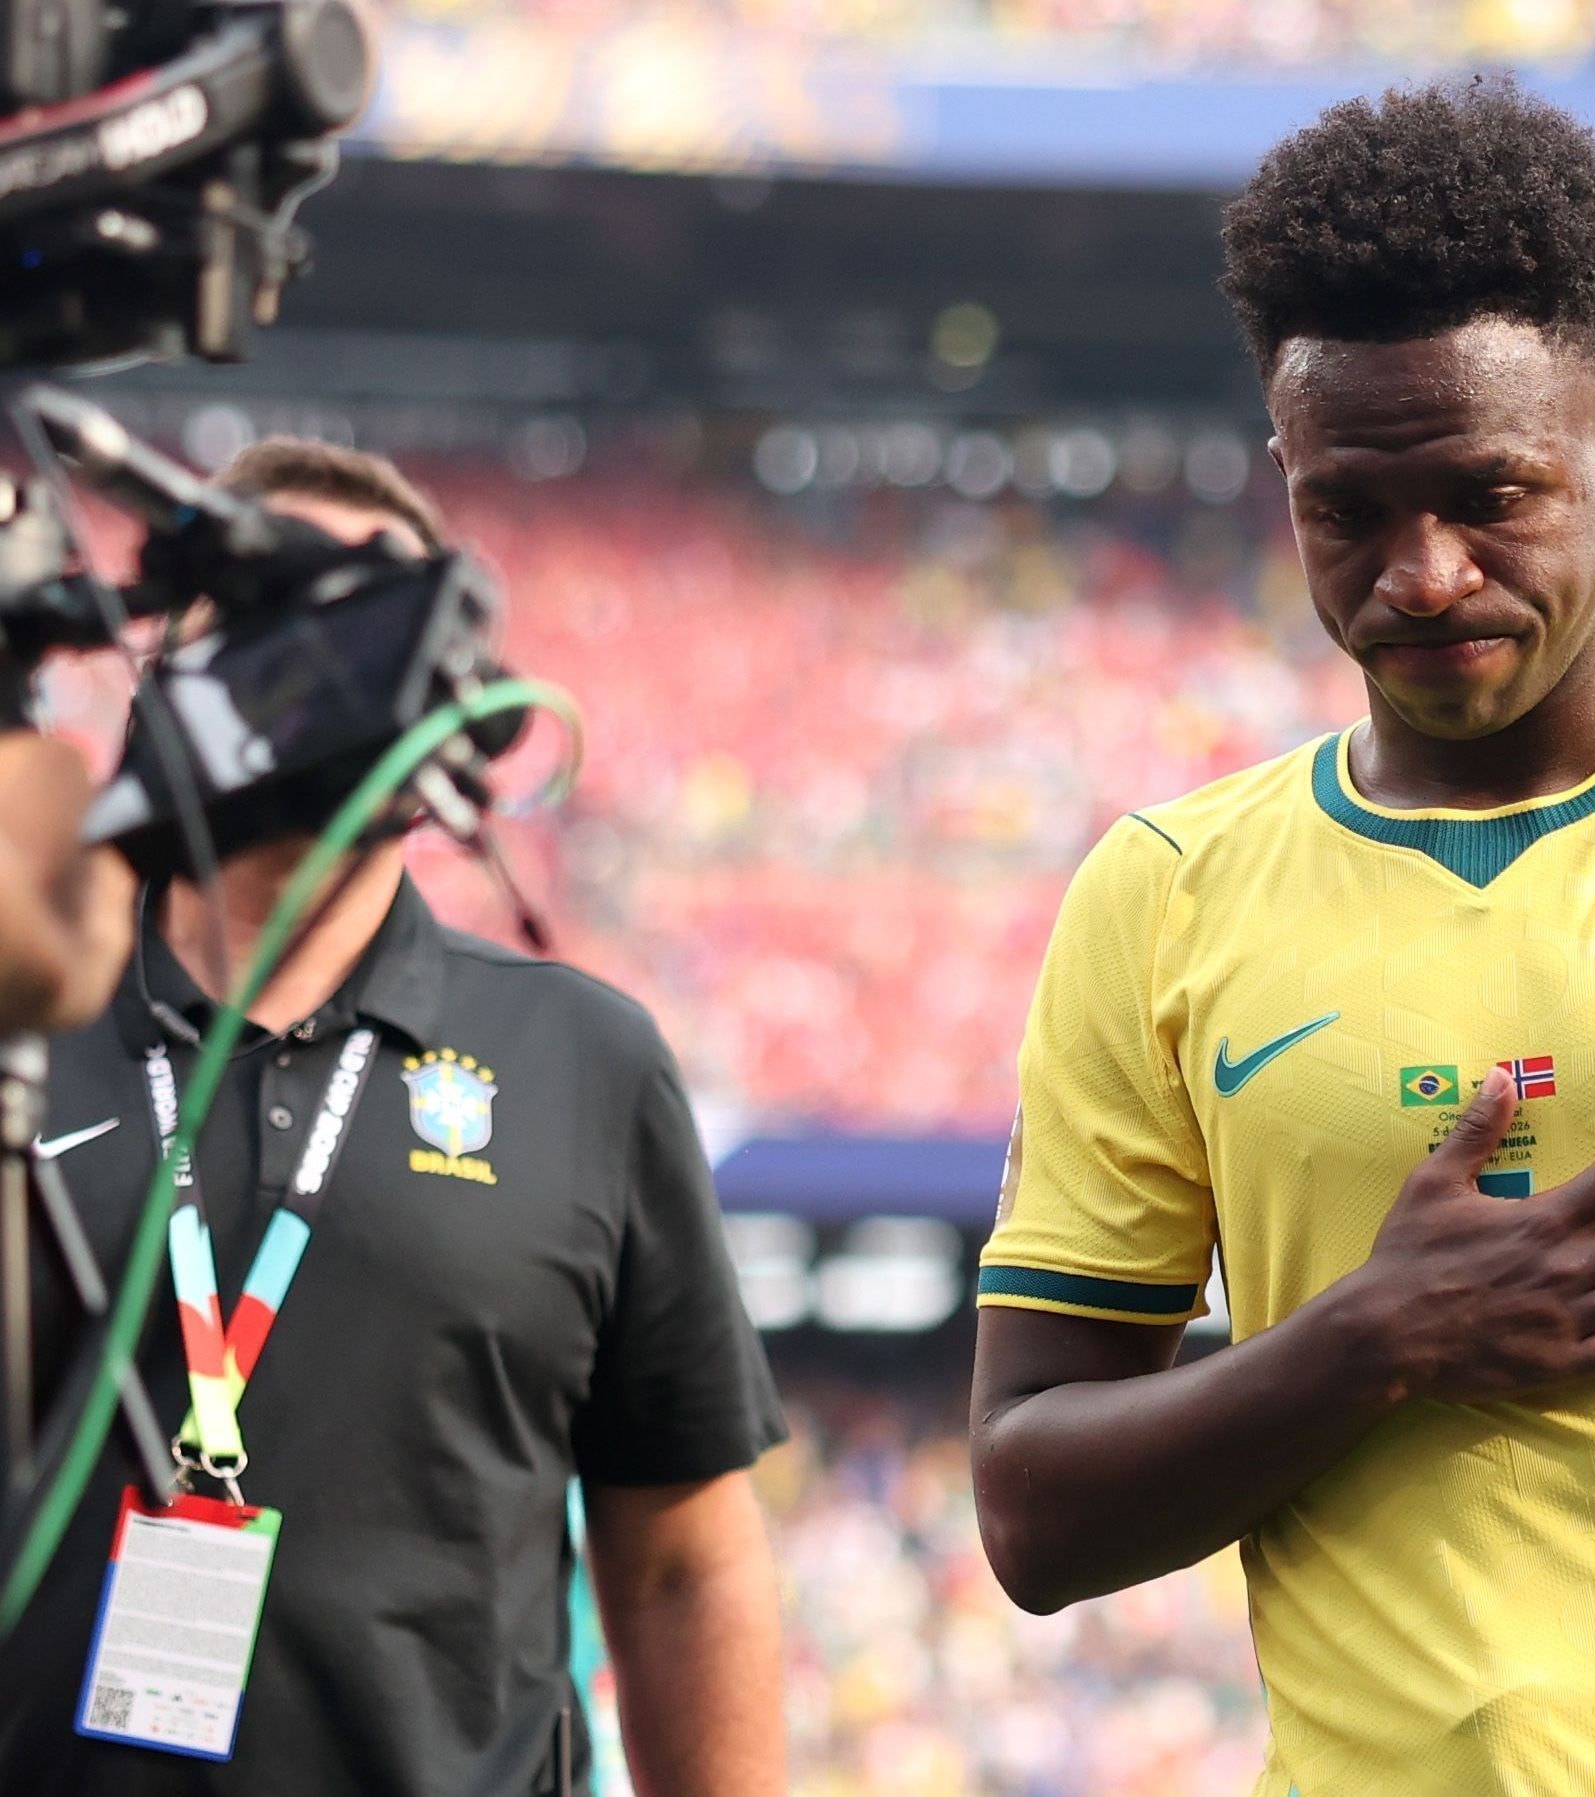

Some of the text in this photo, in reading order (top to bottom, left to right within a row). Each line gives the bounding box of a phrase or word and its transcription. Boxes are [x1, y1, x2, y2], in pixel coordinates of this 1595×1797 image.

[1433, 1126, 1440, 1136] 5
[1507, 1123, 1530, 1133] 026
[1499, 1135, 1537, 1149] RUEGA
[1510, 1150, 1532, 1161] EUA
